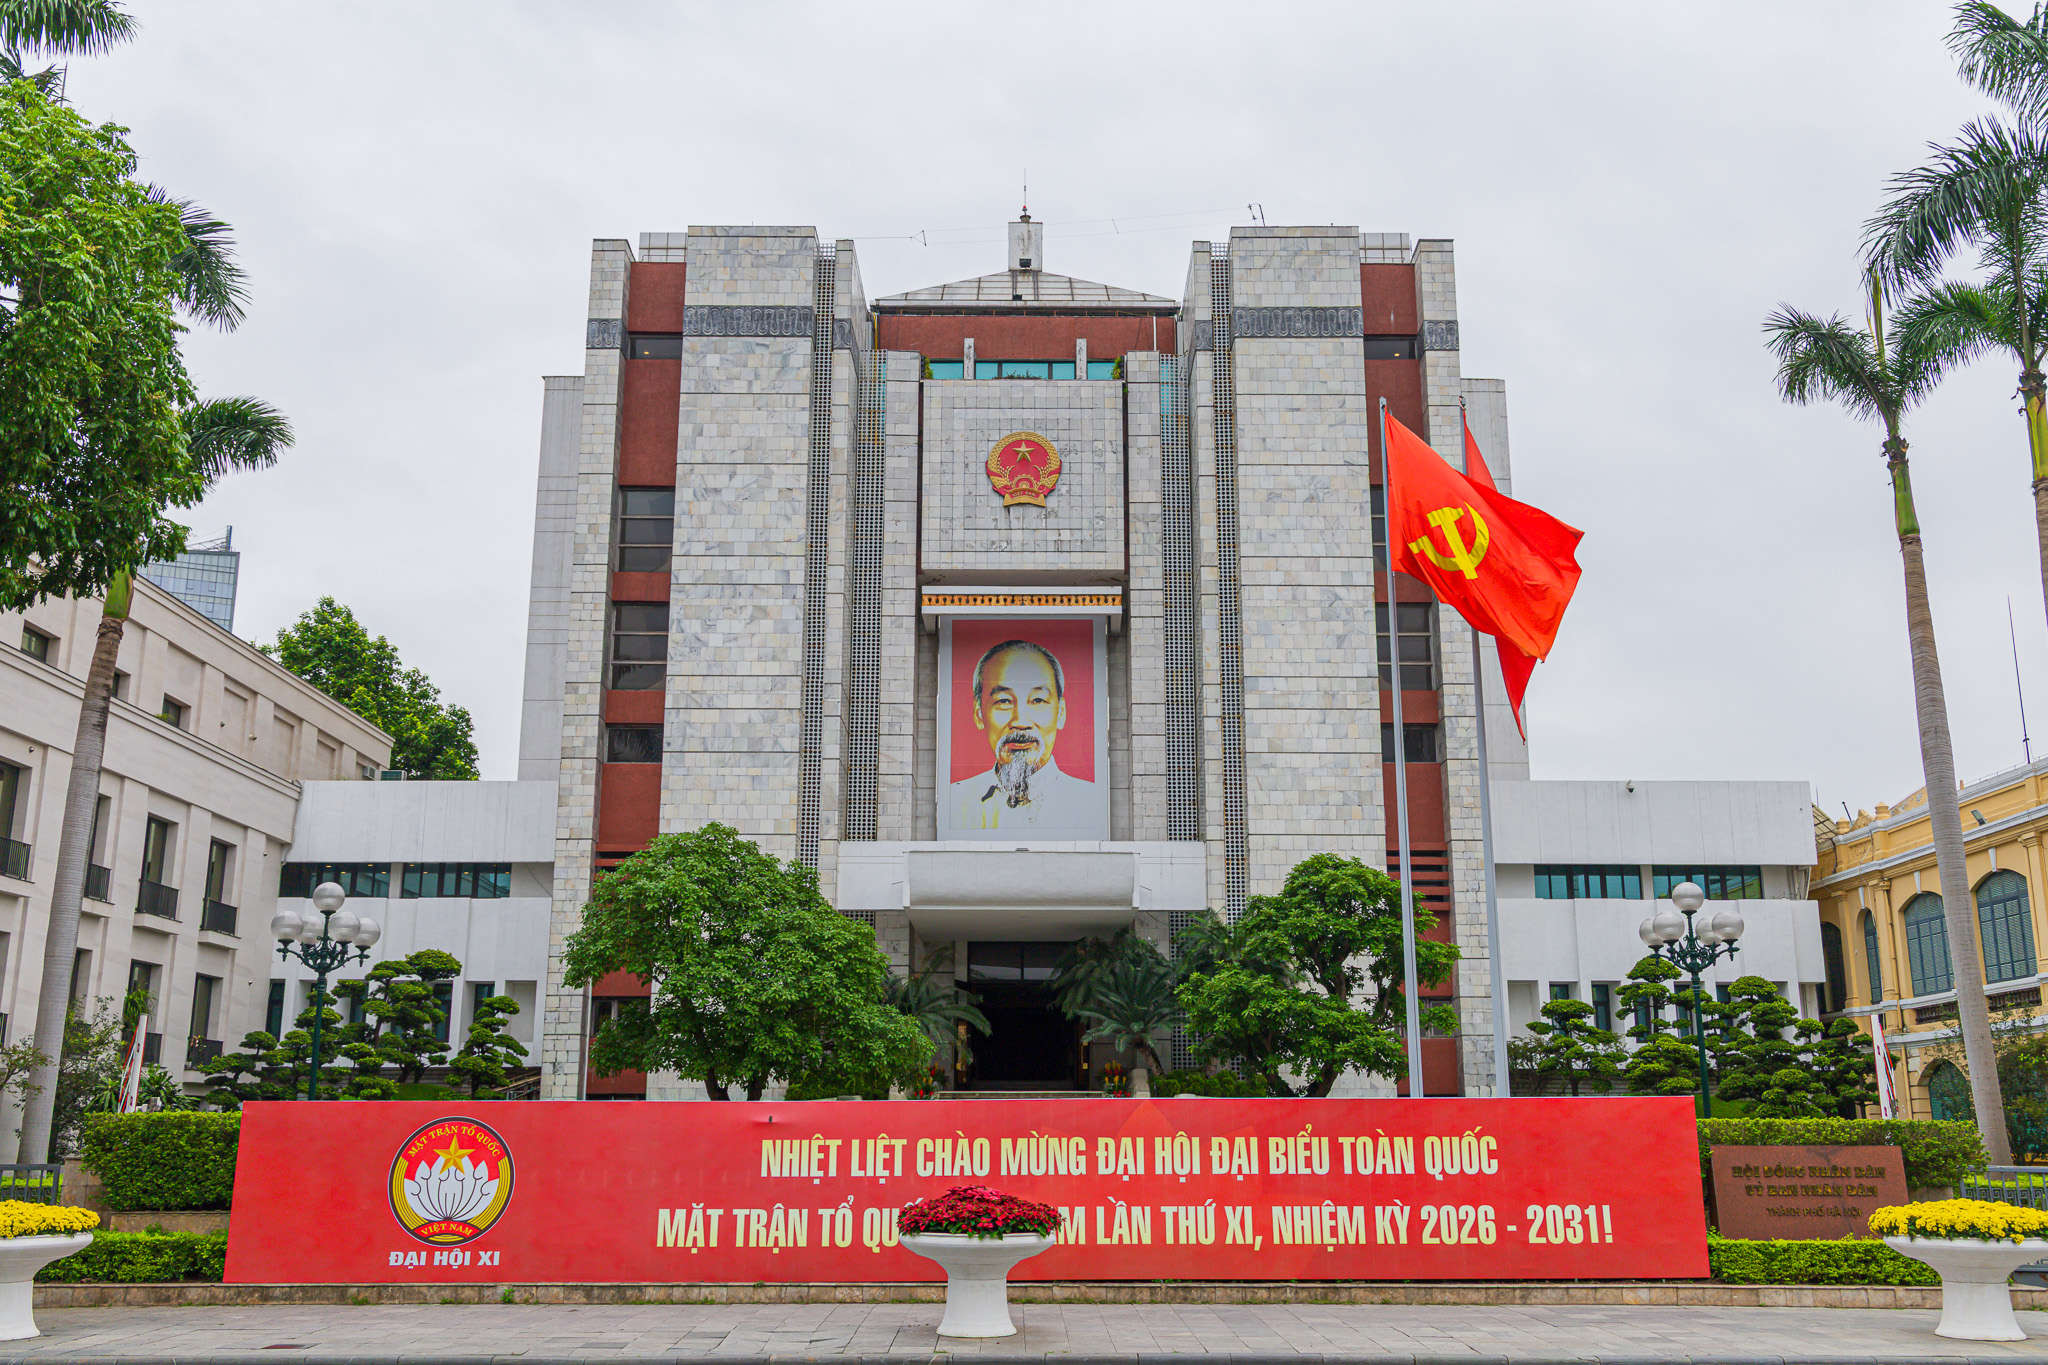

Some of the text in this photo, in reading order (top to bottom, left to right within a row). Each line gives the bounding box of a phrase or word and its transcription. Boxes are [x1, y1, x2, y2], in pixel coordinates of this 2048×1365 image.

[408, 1124, 500, 1157] MẶT TRẬN TỔ QUỐC
[760, 1123, 1499, 1185] NHIỆT LIỆT CHÀO MỪNG ĐẠI HỘI ĐẠI BIỂU TOÀN QUỐC
[1732, 1163, 1761, 1181] HỘI
[1808, 1163, 1851, 1178] NHÂN
[1854, 1163, 1886, 1178] DÂN
[1767, 1184, 1798, 1197] BAN
[1801, 1183, 1843, 1197] NHÂN
[1846, 1183, 1878, 1197] DÂN
[1766, 1204, 1862, 1219] THÀNH PHỐ HÀ NỘI
[421, 1222, 473, 1236] VIỆT NAM
[656, 1202, 724, 1254] MẶT
[732, 1202, 808, 1254] TRẬN
[817, 1195, 855, 1248] TỔ
[862, 1197, 924, 1253] QU
[1096, 1196, 1152, 1245] LẦN
[1160, 1198, 1217, 1245] THỨ
[1224, 1206, 1263, 1252] XI,
[1272, 1200, 1366, 1253] NHIỆM
[1374, 1199, 1411, 1245] KỲ
[1420, 1204, 1497, 1245] 2026
[1526, 1204, 1614, 1245] 2031!
[389, 1248, 501, 1269] ĐẠI HỘI XI
